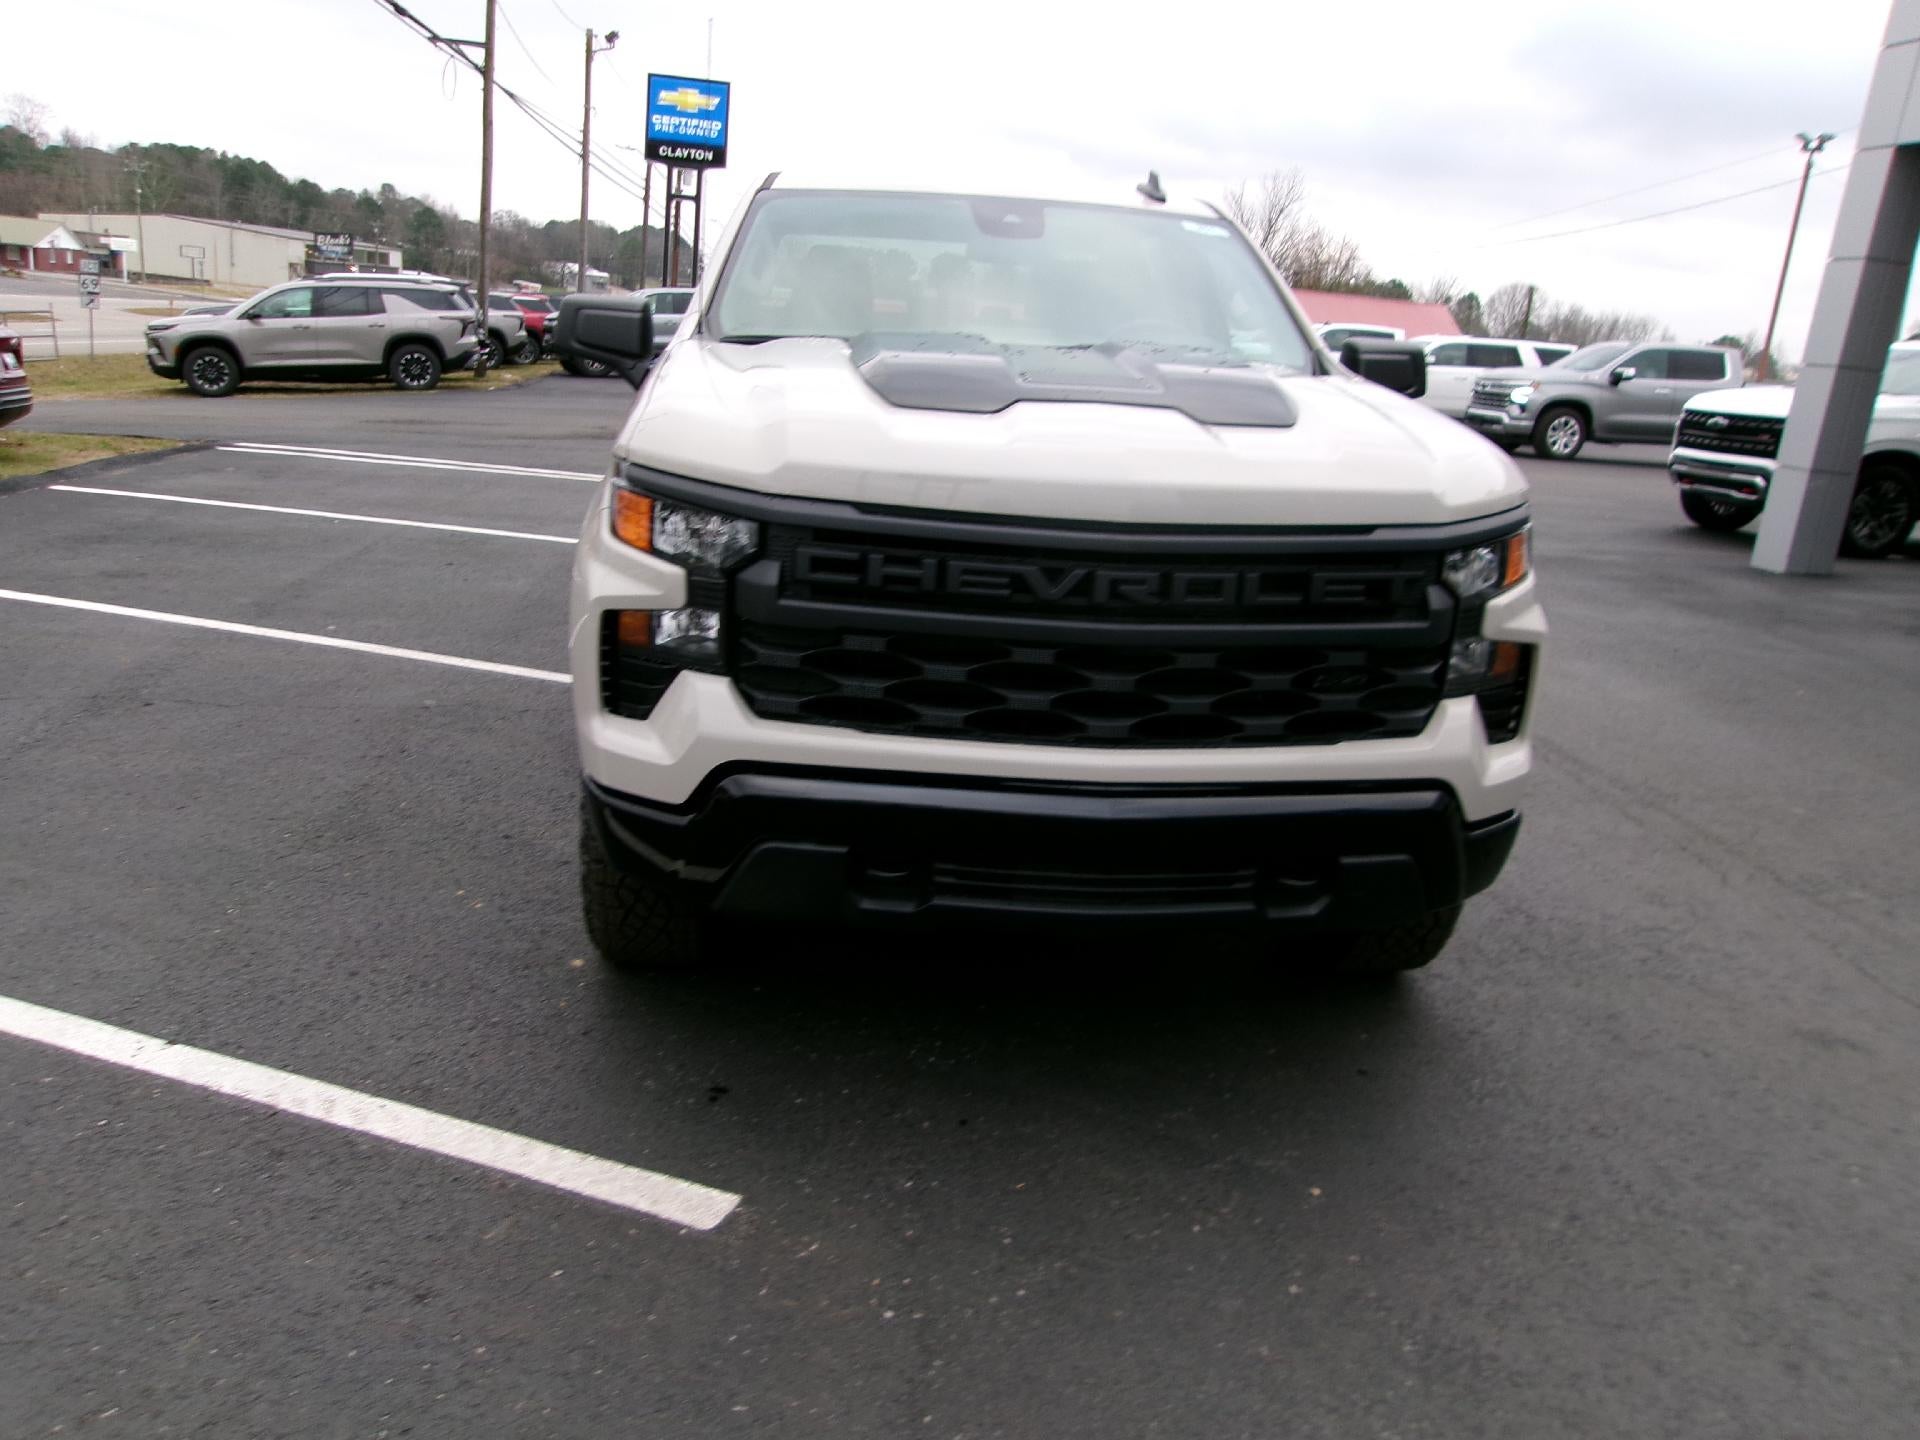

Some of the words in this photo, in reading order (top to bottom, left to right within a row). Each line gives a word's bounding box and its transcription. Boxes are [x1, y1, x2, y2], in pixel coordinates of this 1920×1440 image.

[652, 114, 721, 130] CERTIFIED
[654, 123, 718, 138] PRE-OWNED
[659, 145, 713, 161] CLAYTON
[795, 547, 1425, 605] CHEVROLET
